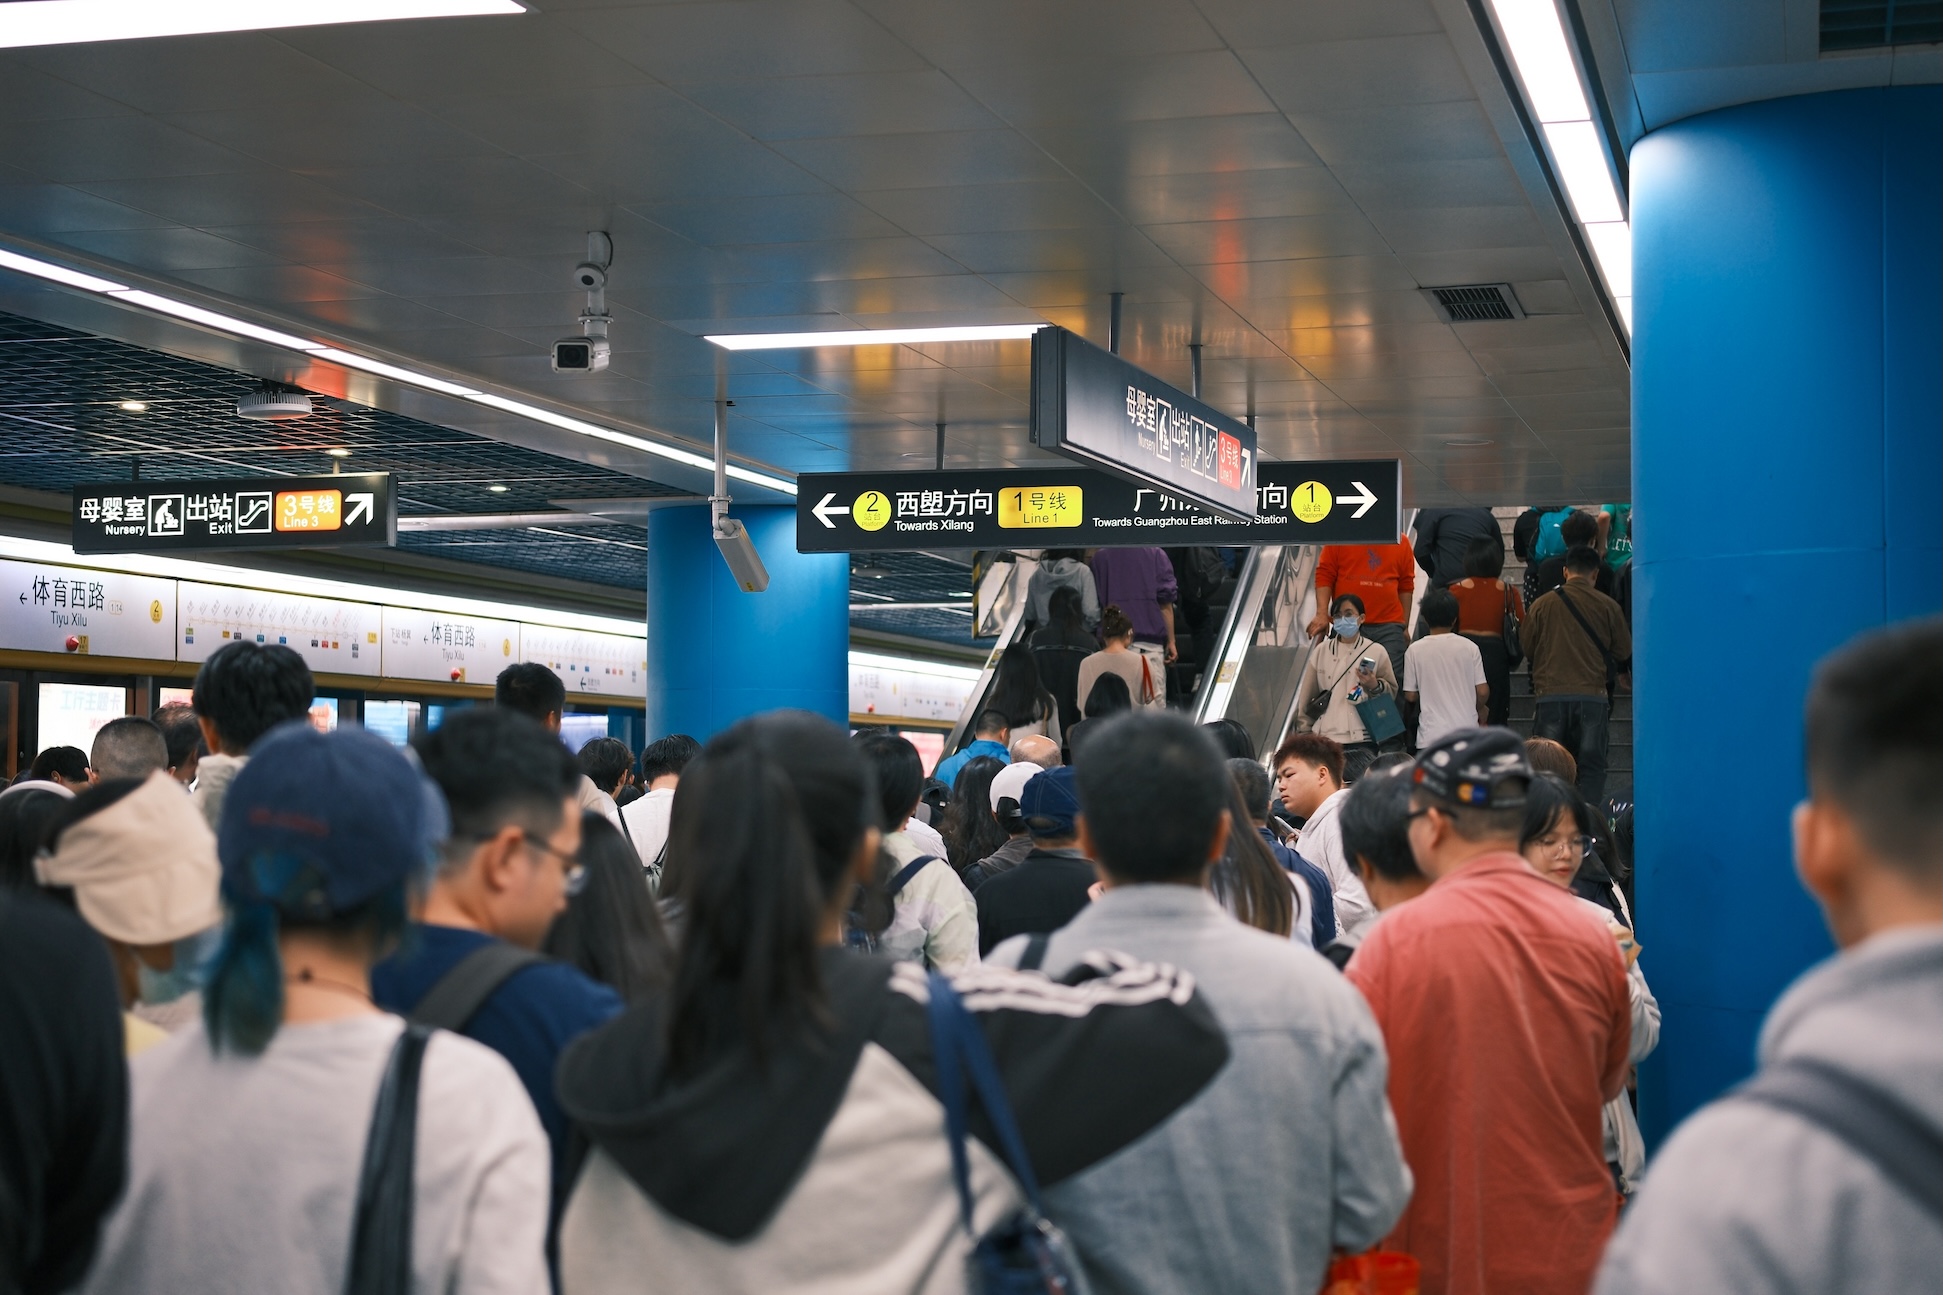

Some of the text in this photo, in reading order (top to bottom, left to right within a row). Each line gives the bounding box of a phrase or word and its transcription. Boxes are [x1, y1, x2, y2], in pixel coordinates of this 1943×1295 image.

[1126, 385, 1239, 469] 母婴室 出站 3号线
[1138, 432, 1156, 456] Nursery
[1180, 452, 1190, 470] Exit
[866, 492, 879, 512] 2
[896, 488, 993, 517] 西塱方向
[1013, 491, 1067, 512] 1号线
[1306, 482, 1314, 503] 1
[79, 493, 335, 523] 母婴室 出站 3号线
[1303, 503, 1321, 512] 站台
[105, 515, 319, 537] Nursery Exit Line 3
[894, 519, 974, 532] Towards Xilang
[1023, 513, 1058, 524] Line 1
[1092, 517, 1132, 528] Towards
[1134, 516, 1188, 528] Guangzhou
[1191, 515, 1212, 526] East
[1253, 514, 1287, 525] Station
[32, 574, 105, 612] 体育西路
[154, 599, 160, 613] 2
[50, 610, 88, 628] Tiyu Xilu
[431, 620, 475, 649] 体育西路
[442, 648, 465, 662] Tiyu Xilu
